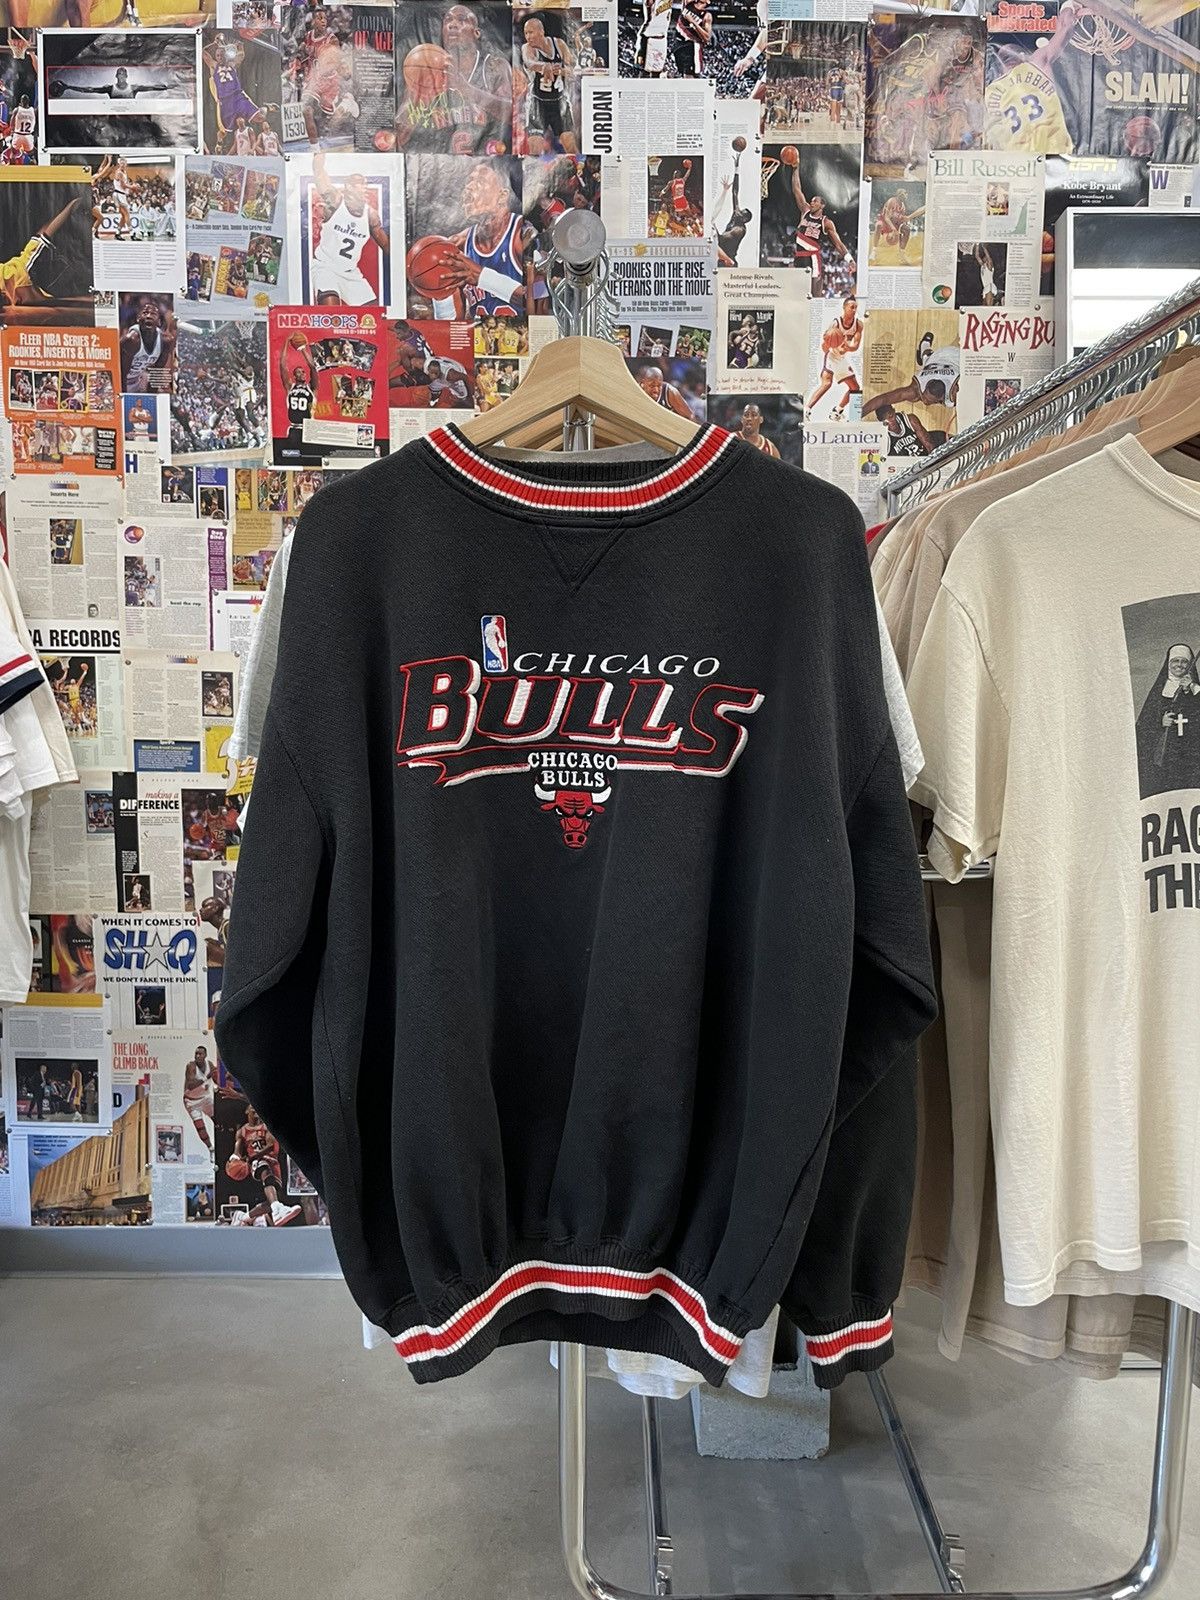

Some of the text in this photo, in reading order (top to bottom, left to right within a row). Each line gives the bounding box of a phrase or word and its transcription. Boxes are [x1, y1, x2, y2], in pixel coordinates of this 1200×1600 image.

[998, 1, 1045, 18] Sports
[986, 11, 1057, 33] Illustrated
[1009, 72, 1056, 97] JABBAR
[1104, 70, 1190, 104] SLAM!
[592, 90, 613, 153] JORDAN
[1004, 94, 1044, 134] 33
[20, 121, 32, 133] 12
[285, 122, 306, 138] 1530
[935, 158, 1037, 178] Bill Russell
[1063, 180, 1122, 192] Kobe Bryant
[1151, 170, 1170, 190] W
[339, 237, 356, 260] 2
[613, 261, 707, 279] ROOKIES ON THE RISE.
[606, 279, 713, 296] VETERANS ON THE MOVE.
[277, 314, 358, 329] NBA HOOPS
[19, 332, 100, 347] FLEER NBA SERIES 2:
[963, 311, 1055, 352] RAGING BU
[9, 345, 112, 360] ROOKIES, INSERTS & MORE!
[1007, 352, 1016, 363] W
[290, 397, 308, 411] 50
[821, 429, 883, 445] Lanier
[125, 454, 138, 473] H
[887, 465, 896, 473] S
[49, 629, 121, 648] RECORDS
[487, 661, 502, 670] NBA
[512, 651, 721, 678] CHICAGO
[397, 655, 765, 778] BULLS
[528, 751, 619, 771] CHICAGO
[542, 772, 606, 788] BULLS
[145, 789, 173, 799] making
[119, 798, 180, 810] DIFFERENCE
[102, 918, 197, 927] WHEN IT COMES TO
[113, 1042, 149, 1056] THE LONG
[113, 1056, 159, 1070] CLIMB BACK
